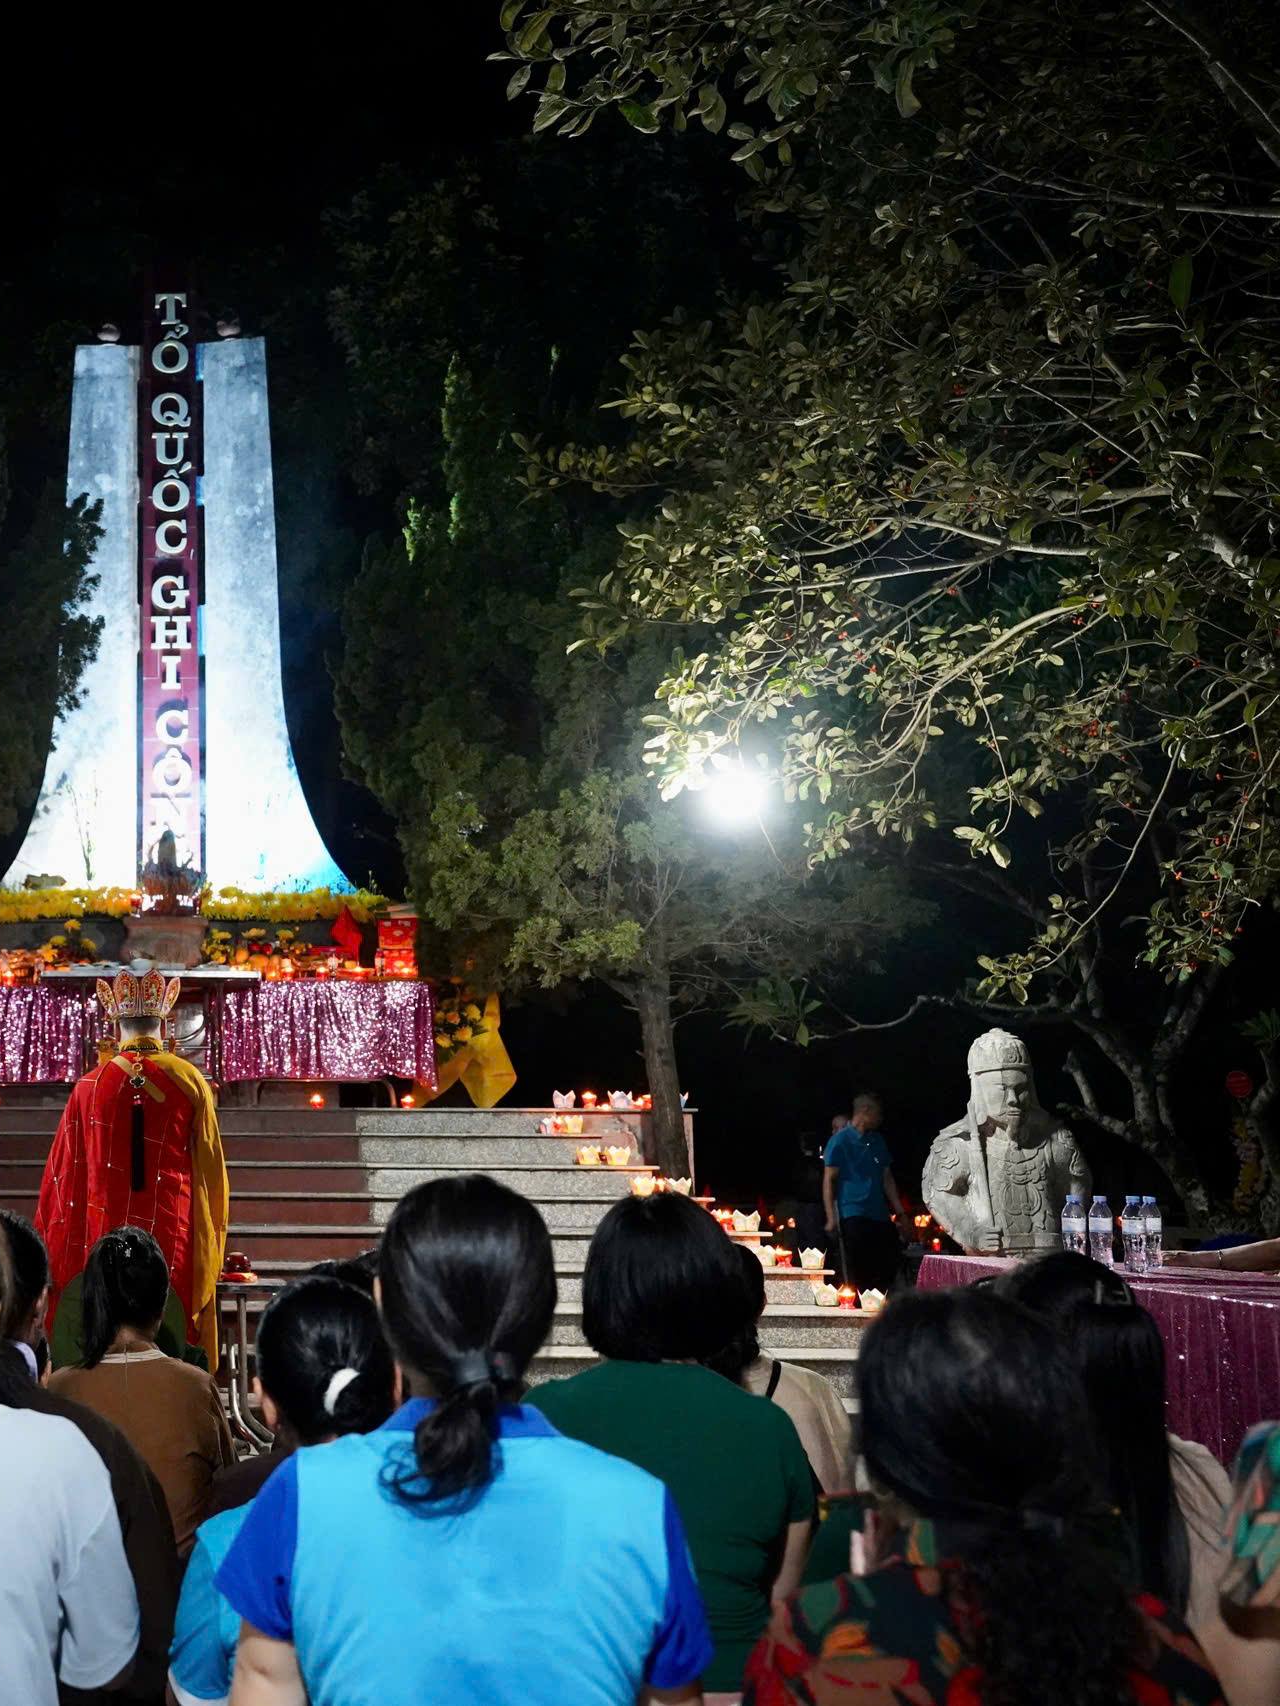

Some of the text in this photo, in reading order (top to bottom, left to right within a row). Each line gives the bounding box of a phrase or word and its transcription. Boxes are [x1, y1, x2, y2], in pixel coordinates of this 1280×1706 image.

[151, 292, 190, 374] TỔ
[151, 392, 193, 555] QUỐC
[150, 575, 193, 691] GHI
